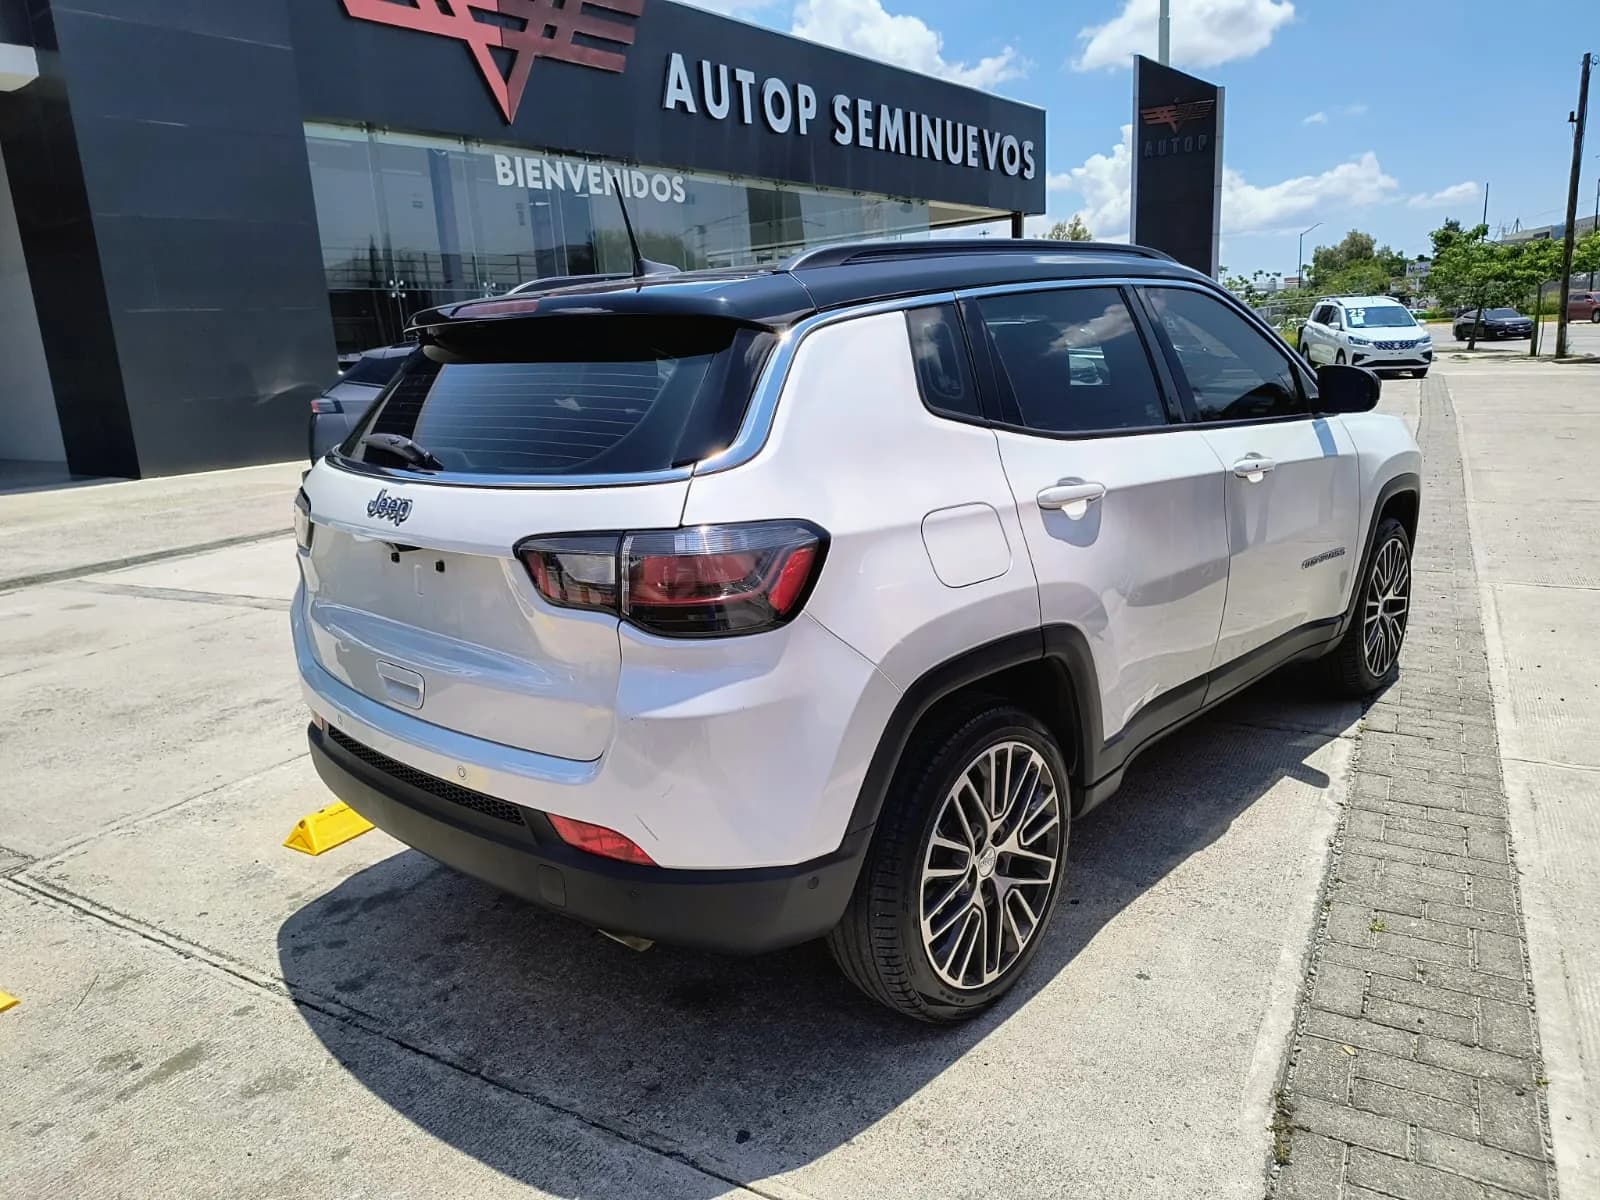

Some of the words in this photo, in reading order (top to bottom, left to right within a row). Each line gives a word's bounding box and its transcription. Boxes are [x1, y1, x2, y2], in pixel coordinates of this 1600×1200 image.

[662, 52, 818, 136] AUTOP
[831, 94, 1036, 181] SEMINUEVOS
[1143, 134, 1208, 158] AUTOP
[493, 153, 687, 204] BIENVENIDOS
[366, 488, 413, 527] Jeep
